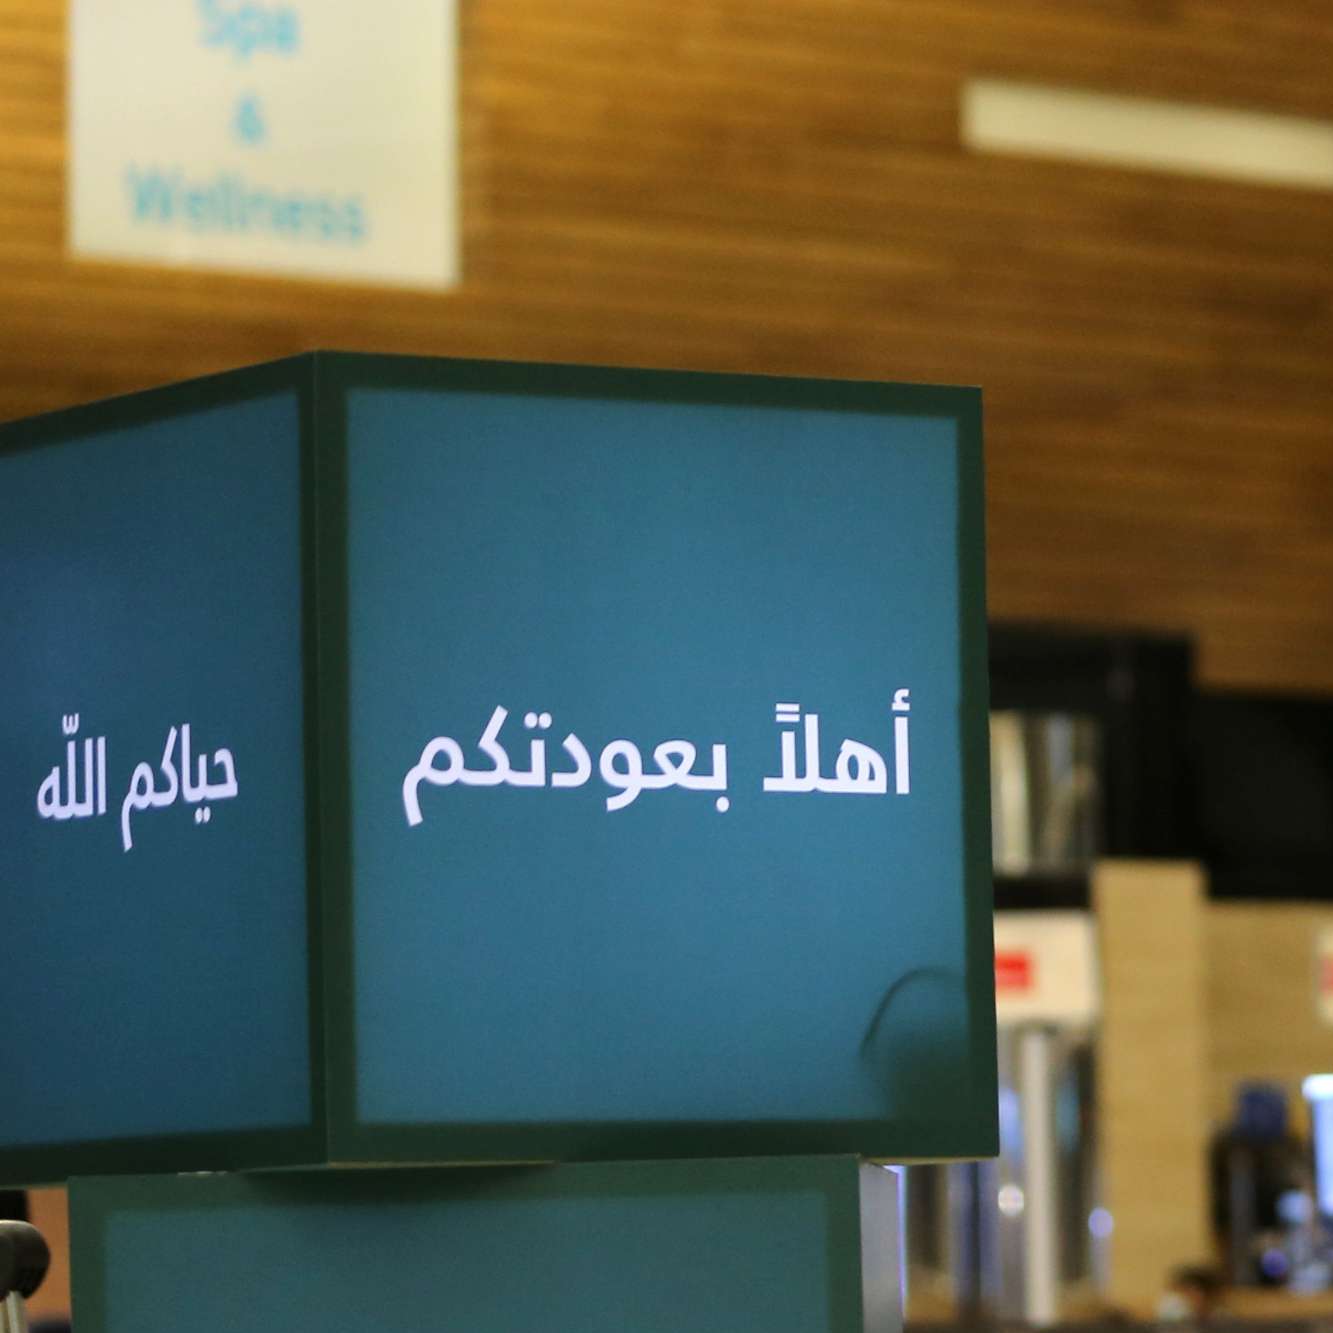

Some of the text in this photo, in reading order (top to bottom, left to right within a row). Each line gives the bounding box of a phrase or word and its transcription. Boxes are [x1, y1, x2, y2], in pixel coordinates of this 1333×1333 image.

[197, 0, 300, 62] Spa
[125, 162, 367, 247] Wellness
[121, 723, 239, 852] حياكم
[402, 688, 911, 827] أهلاً بعودتكم
